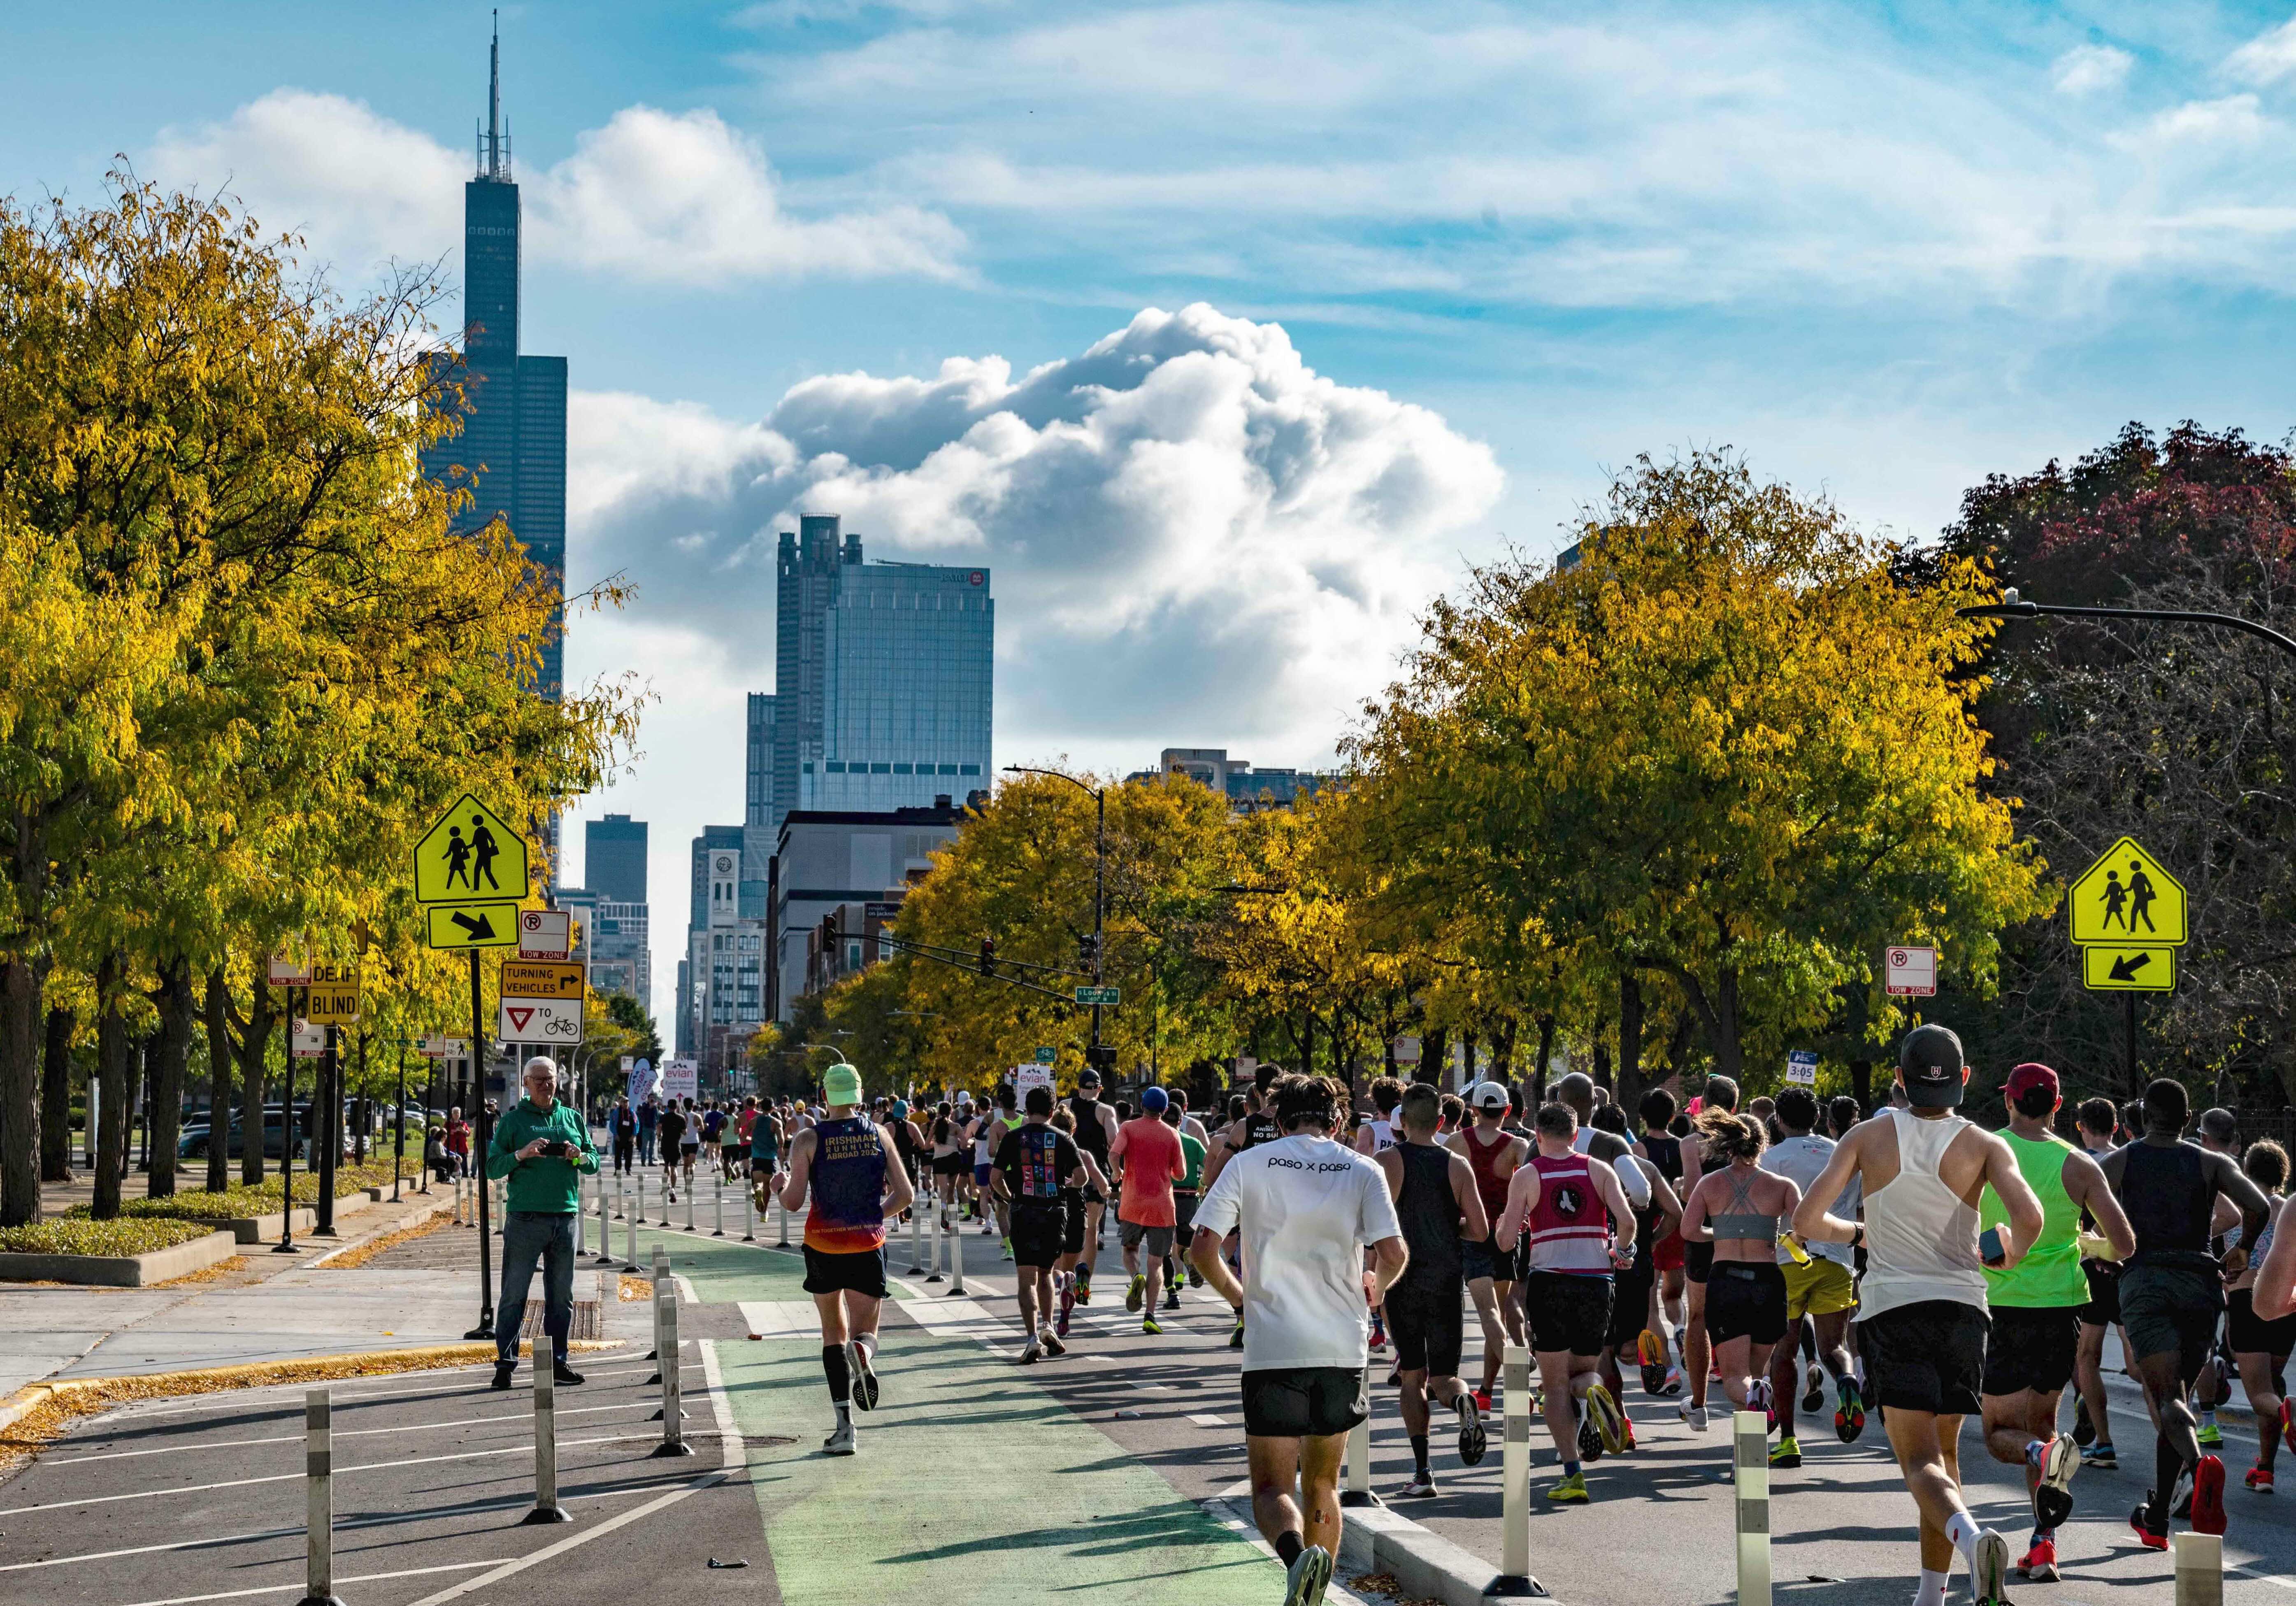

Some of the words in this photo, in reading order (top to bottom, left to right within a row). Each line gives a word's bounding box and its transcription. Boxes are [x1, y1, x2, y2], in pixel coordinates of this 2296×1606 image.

[507, 969, 553, 979] TURNING
[506, 983, 555, 993] VEHICLES
[313, 996, 355, 1014] BLIND
[539, 1008, 551, 1017] TO
[666, 1069, 693, 1078] evian
[1790, 1066, 1813, 1077] 3:05
[634, 1068, 647, 1095] evian
[1020, 1075, 1046, 1083] evian
[641, 1079, 655, 1101] evian
[825, 1134, 876, 1146] IRISHMAN
[826, 1143, 876, 1153] RUNNING
[827, 1151, 859, 1160] ABROAD
[1268, 1157, 1302, 1169] paso
[1319, 1163, 1351, 1173] paso
